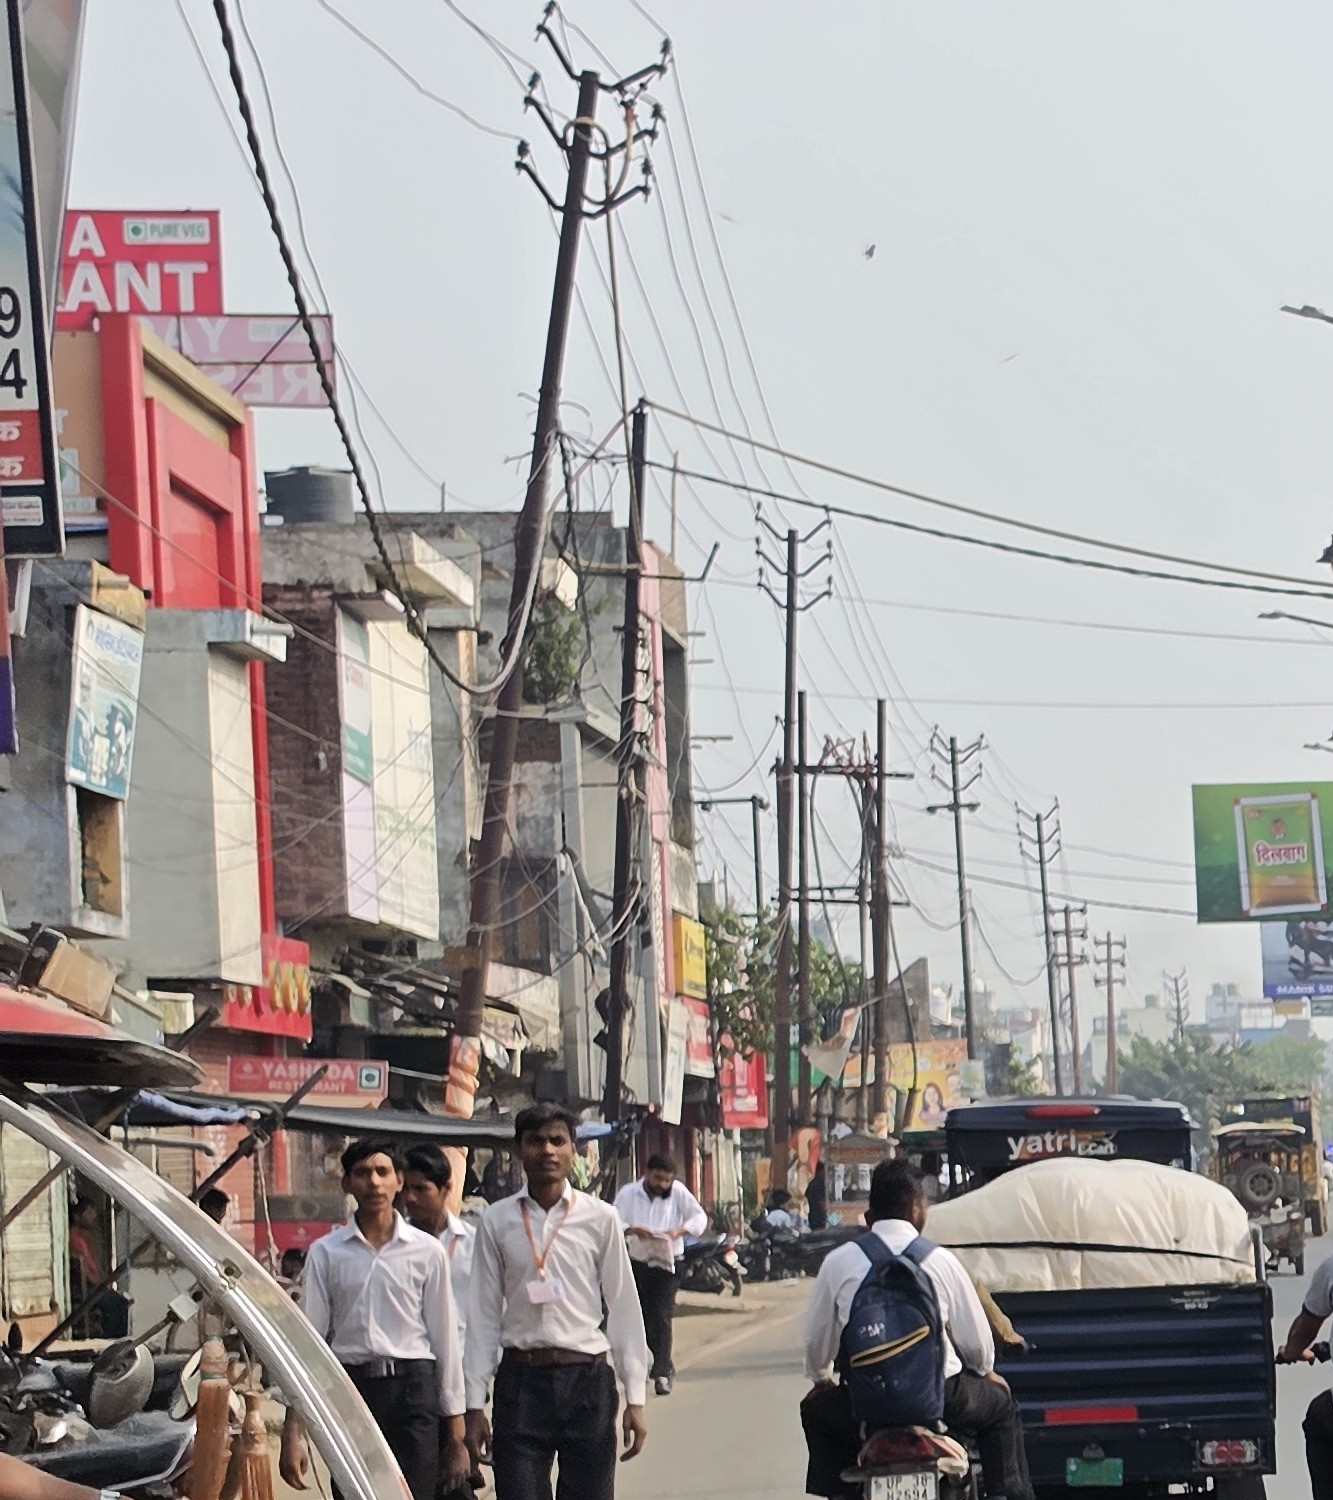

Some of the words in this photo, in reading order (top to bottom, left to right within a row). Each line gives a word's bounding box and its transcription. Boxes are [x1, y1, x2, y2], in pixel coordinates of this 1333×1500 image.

[149, 222, 180, 237] PURE
[183, 222, 206, 237] VEG
[56, 260, 209, 313] ANT
[262, 1063, 355, 1079] YASHDA
[268, 1080, 347, 1093] RESTRANT
[1008, 1129, 1076, 1161] yatri
